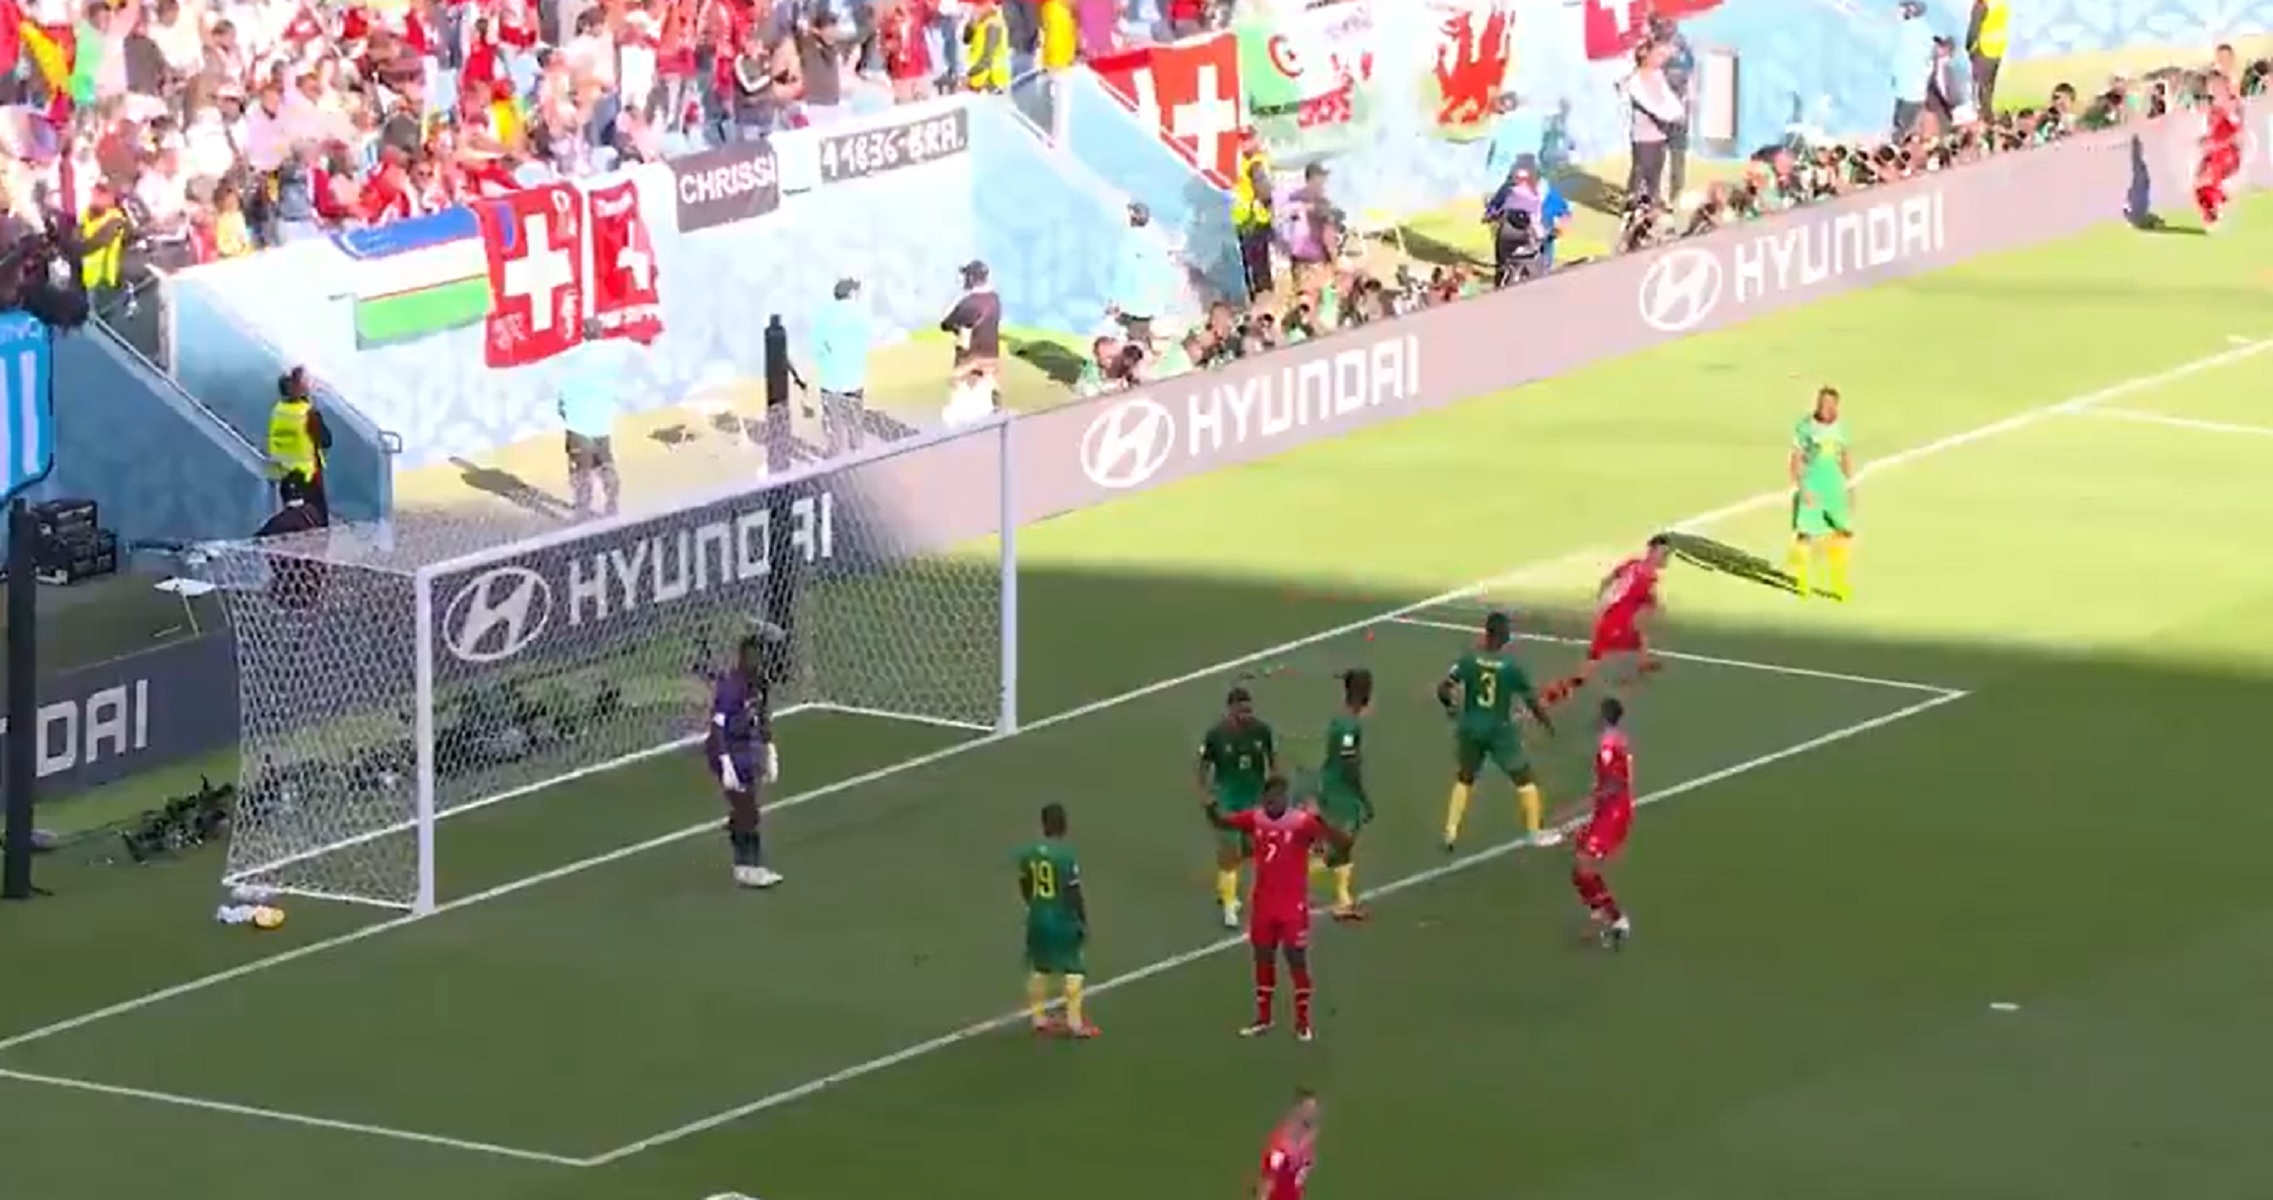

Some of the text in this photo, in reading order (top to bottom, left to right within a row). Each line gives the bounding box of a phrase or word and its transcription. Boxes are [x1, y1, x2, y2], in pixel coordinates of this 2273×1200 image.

[1735, 191, 1944, 303] HYUNDAI
[1188, 335, 1420, 456] HYUNDAI
[567, 492, 833, 626] HYUNDAI
[0, 679, 148, 778] DAI
[1477, 671, 1496, 708] 3
[1030, 860, 1056, 898] 19
[1264, 843, 1277, 863] 7
